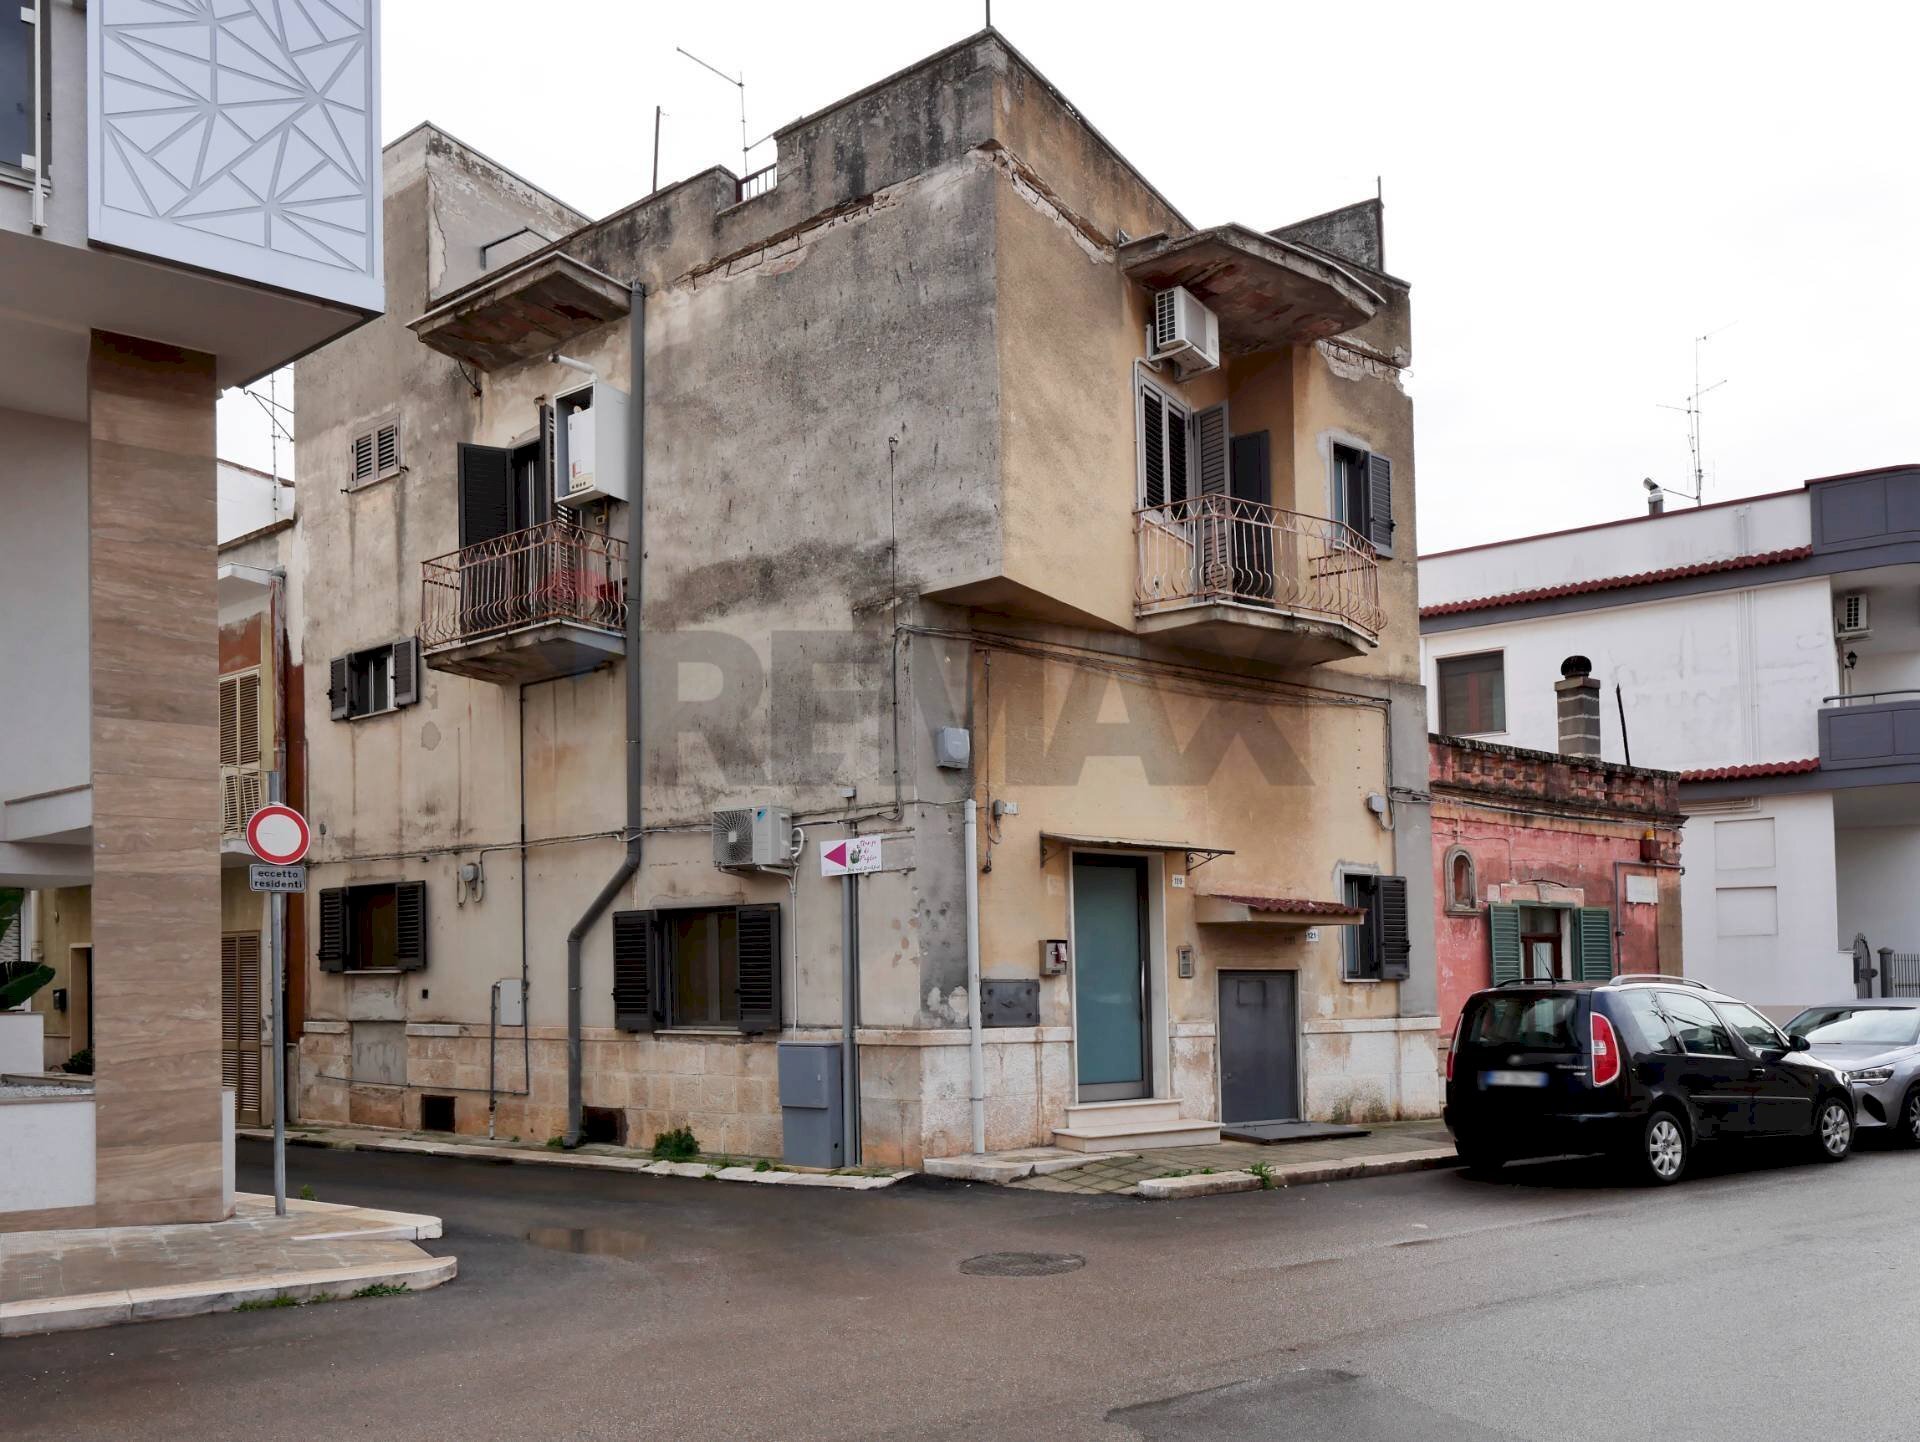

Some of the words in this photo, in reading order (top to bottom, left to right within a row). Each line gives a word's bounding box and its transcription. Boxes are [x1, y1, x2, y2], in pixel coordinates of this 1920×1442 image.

[258, 870, 298, 878] eccetto
[254, 880, 302, 888] residenti
[1307, 931, 1317, 939] 121
